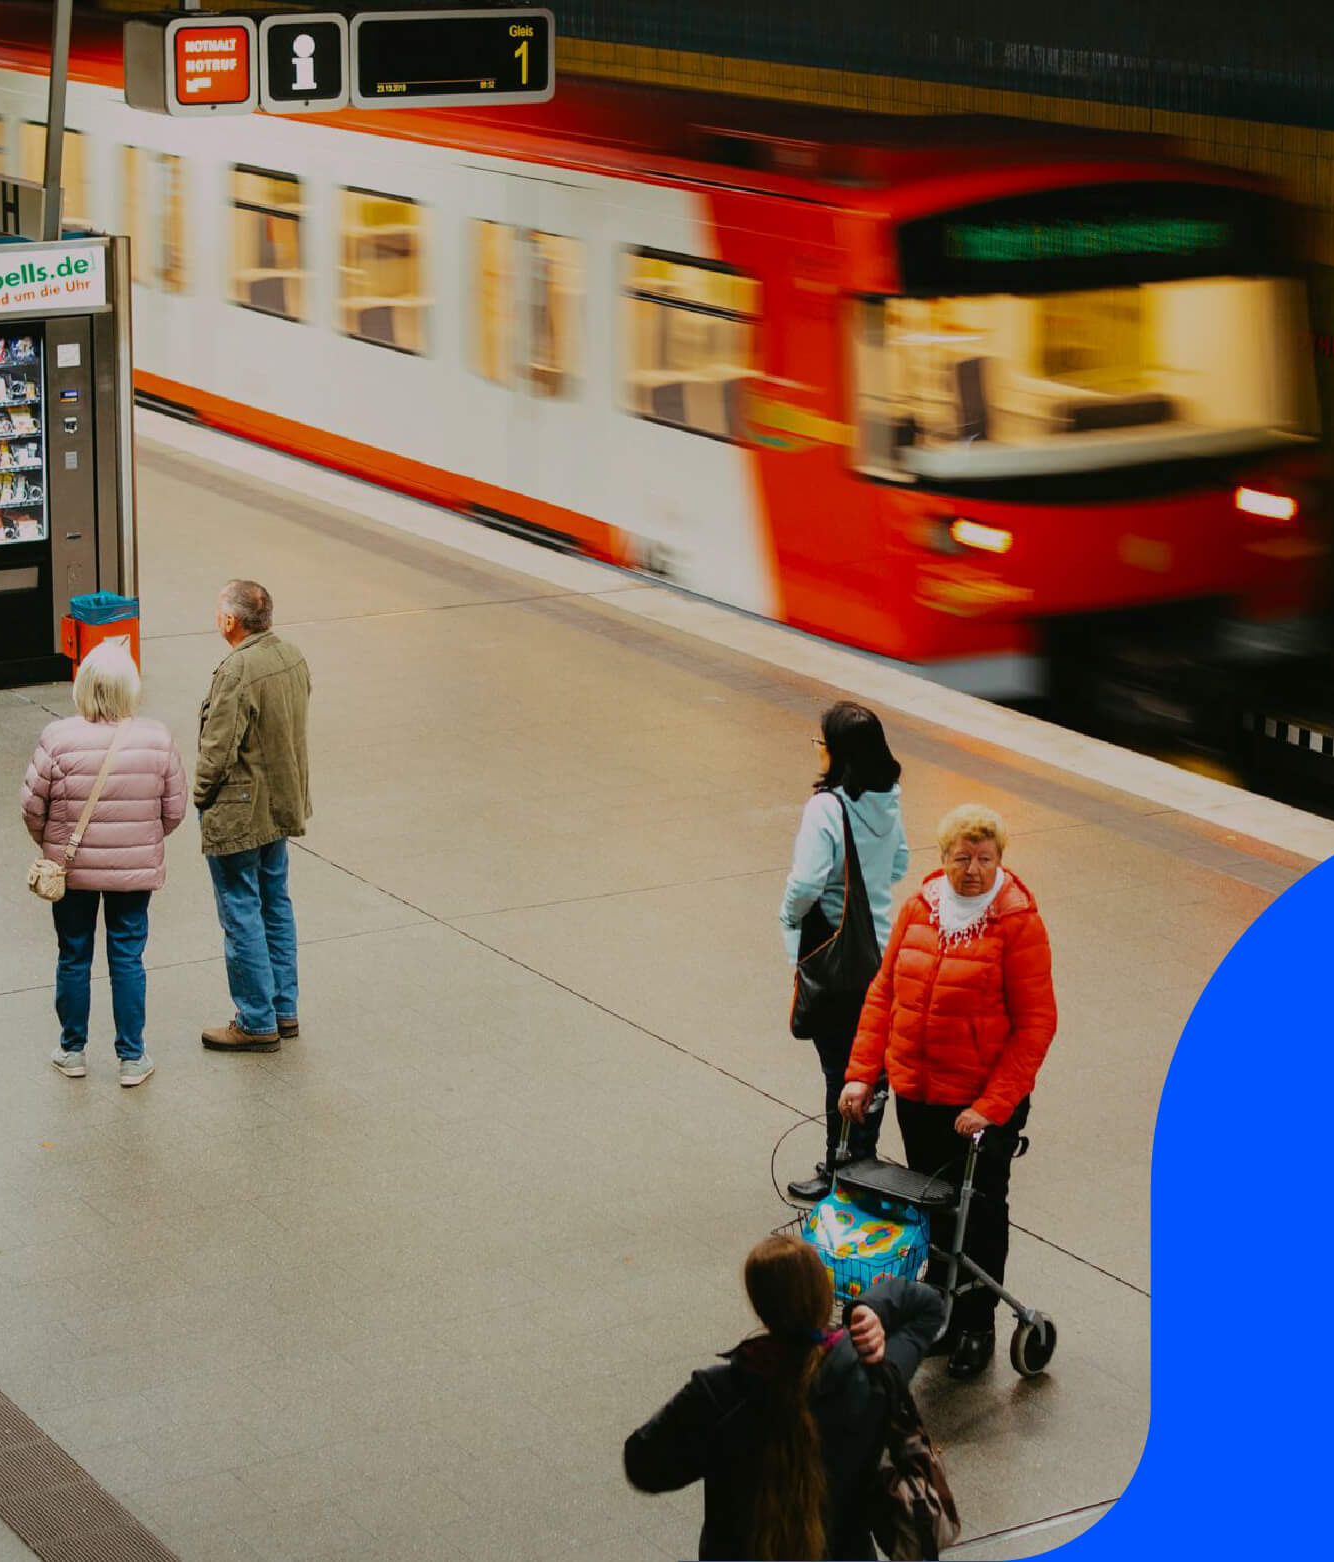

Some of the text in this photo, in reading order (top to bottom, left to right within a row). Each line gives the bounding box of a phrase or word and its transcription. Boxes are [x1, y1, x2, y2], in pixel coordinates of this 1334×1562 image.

[509, 25, 534, 37] Gleis
[186, 58, 237, 72] NOTRUF
[514, 40, 528, 84] 1
[14, 290, 36, 302] um
[40, 283, 60, 297] die
[65, 280, 91, 293] Uhr
